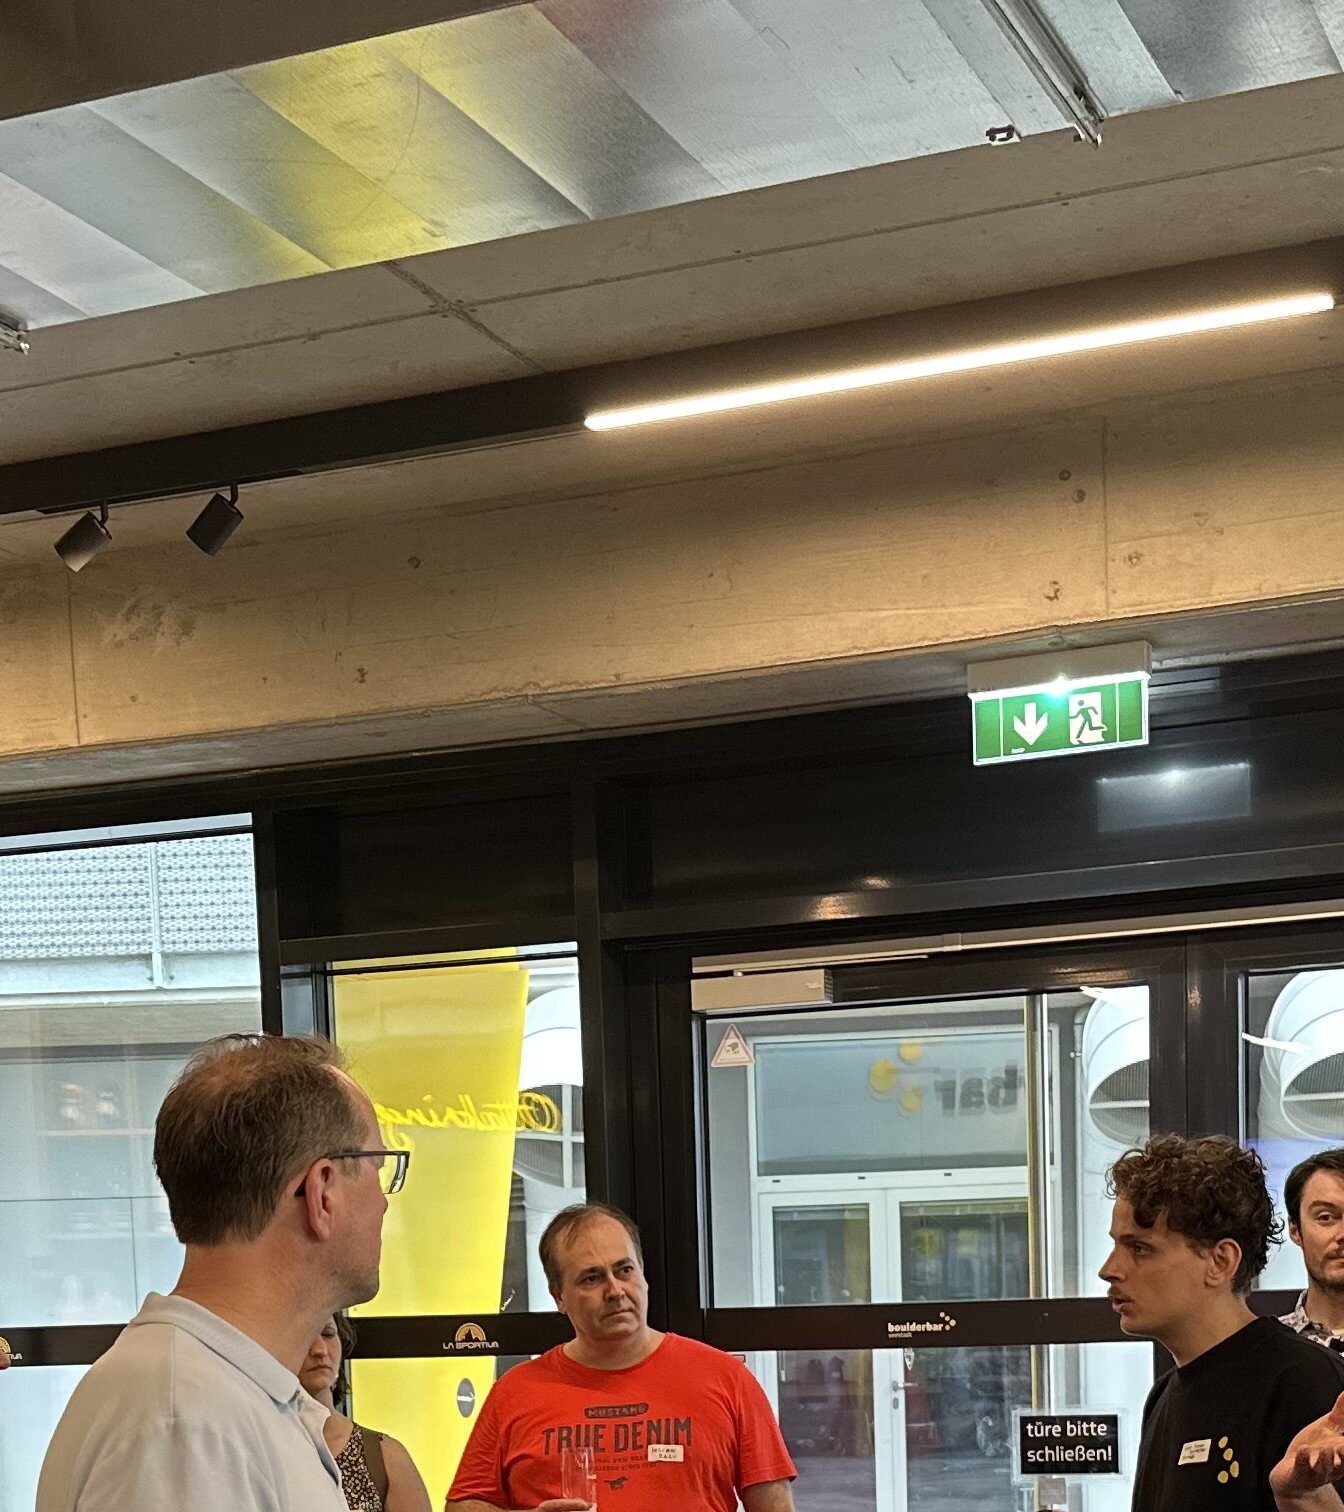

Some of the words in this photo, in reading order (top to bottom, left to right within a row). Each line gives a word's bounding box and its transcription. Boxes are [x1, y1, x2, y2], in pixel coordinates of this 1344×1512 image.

[887, 1321, 944, 1333] boulderbar
[442, 1341, 455, 1350] LA
[455, 1340, 500, 1350] SPORTIVA
[587, 1403, 646, 1418] MUSTANG
[541, 1423, 607, 1455] TRUE
[613, 1415, 692, 1453] DENIM
[1026, 1420, 1062, 1438] türe
[1066, 1419, 1108, 1437] bitte
[1026, 1444, 1113, 1463] schließen!
